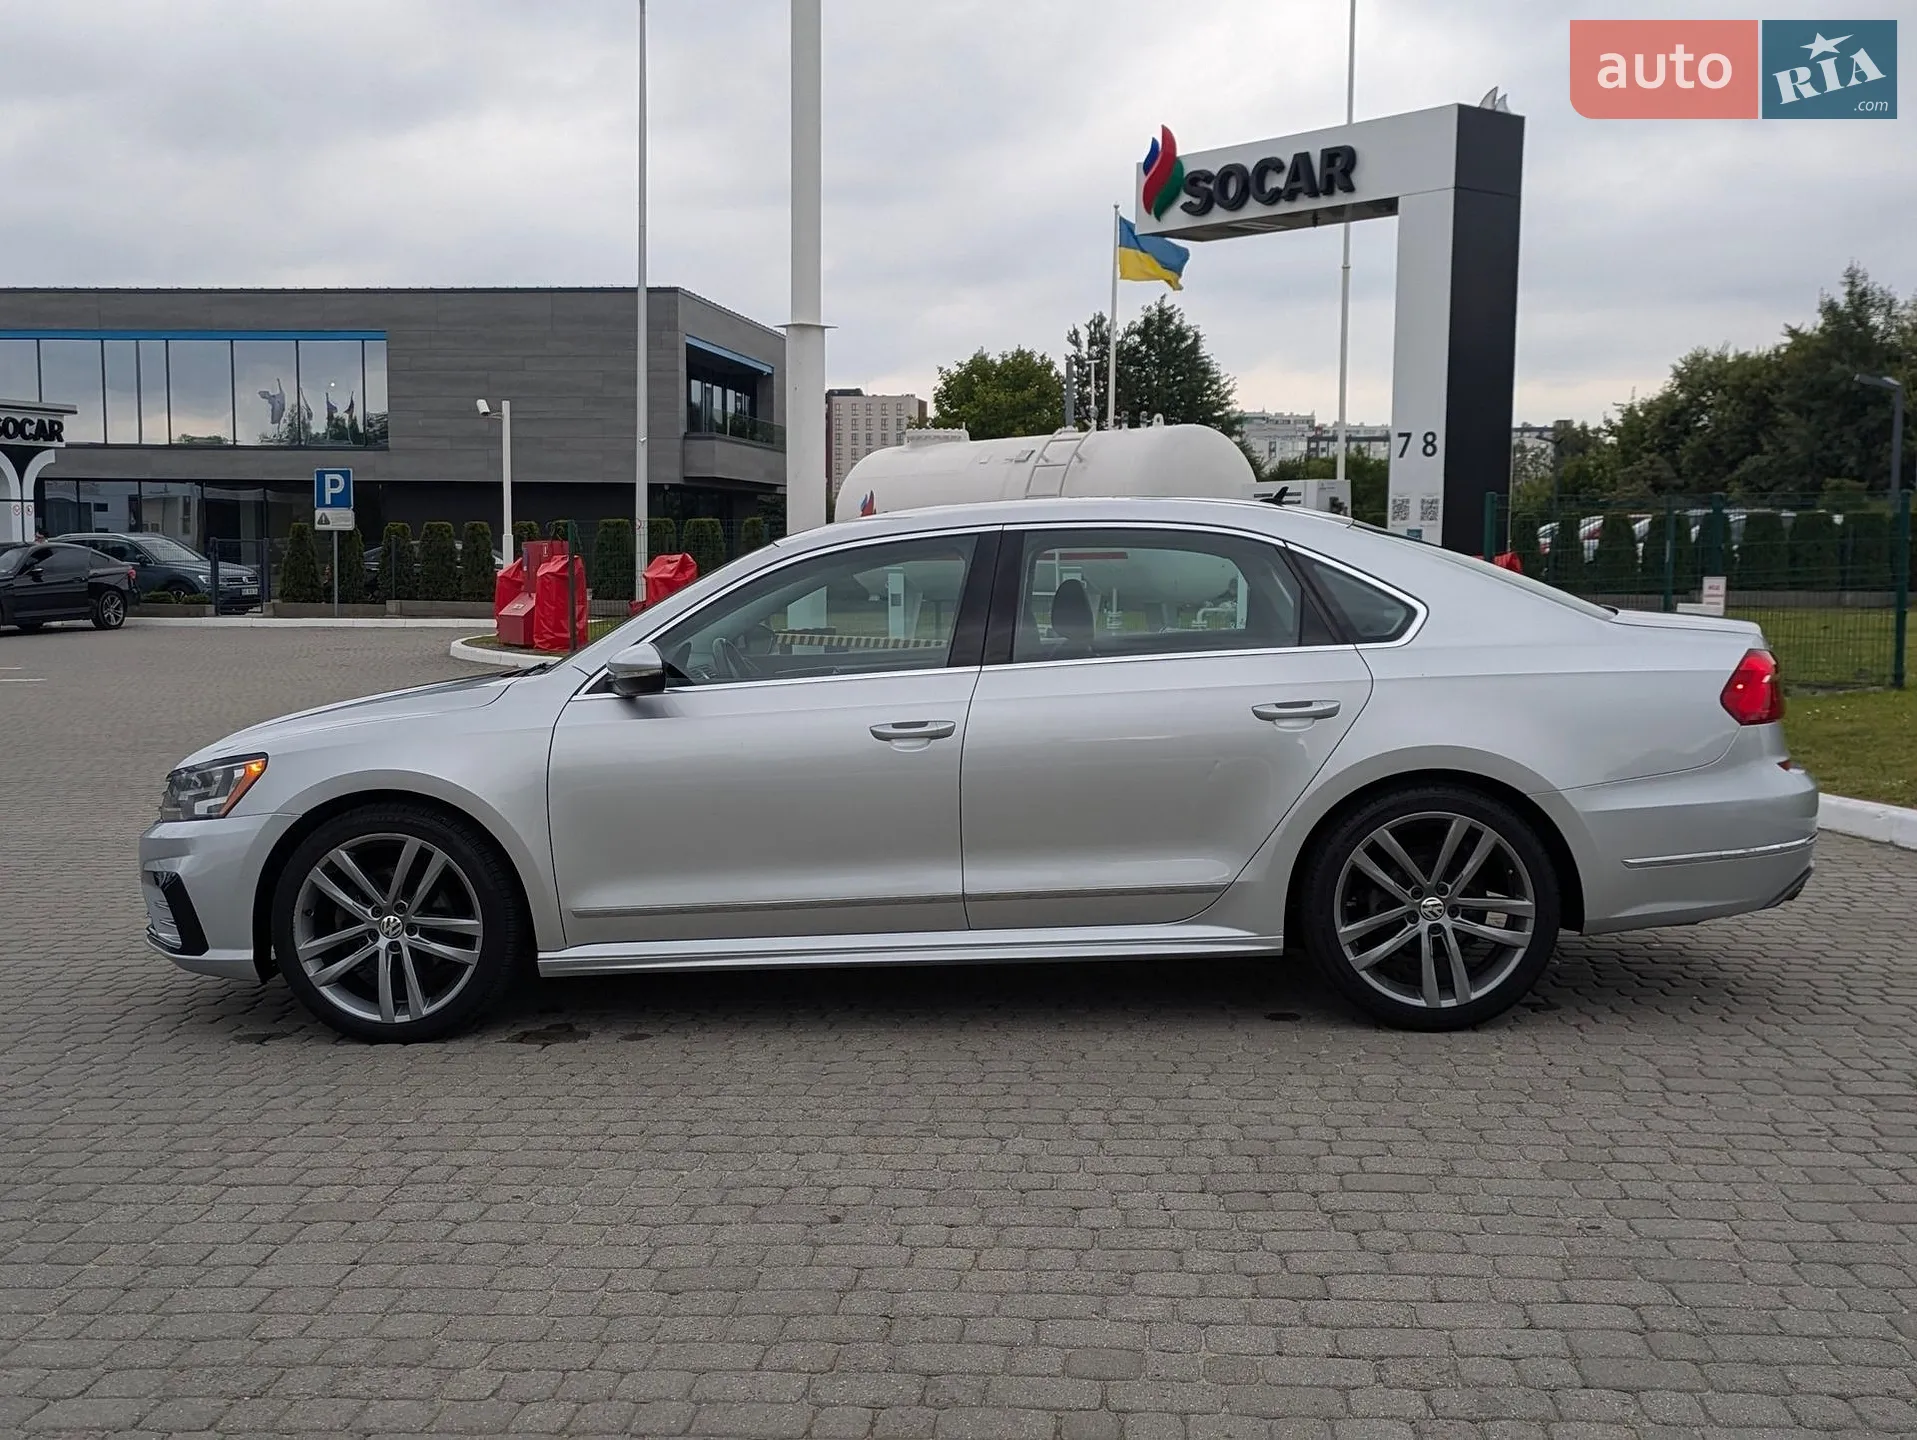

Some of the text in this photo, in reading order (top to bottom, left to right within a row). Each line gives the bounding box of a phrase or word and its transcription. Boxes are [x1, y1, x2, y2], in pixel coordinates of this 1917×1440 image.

[1180, 144, 1357, 217] SOCAR
[0, 416, 64, 442] OCAR
[325, 474, 345, 504] P
